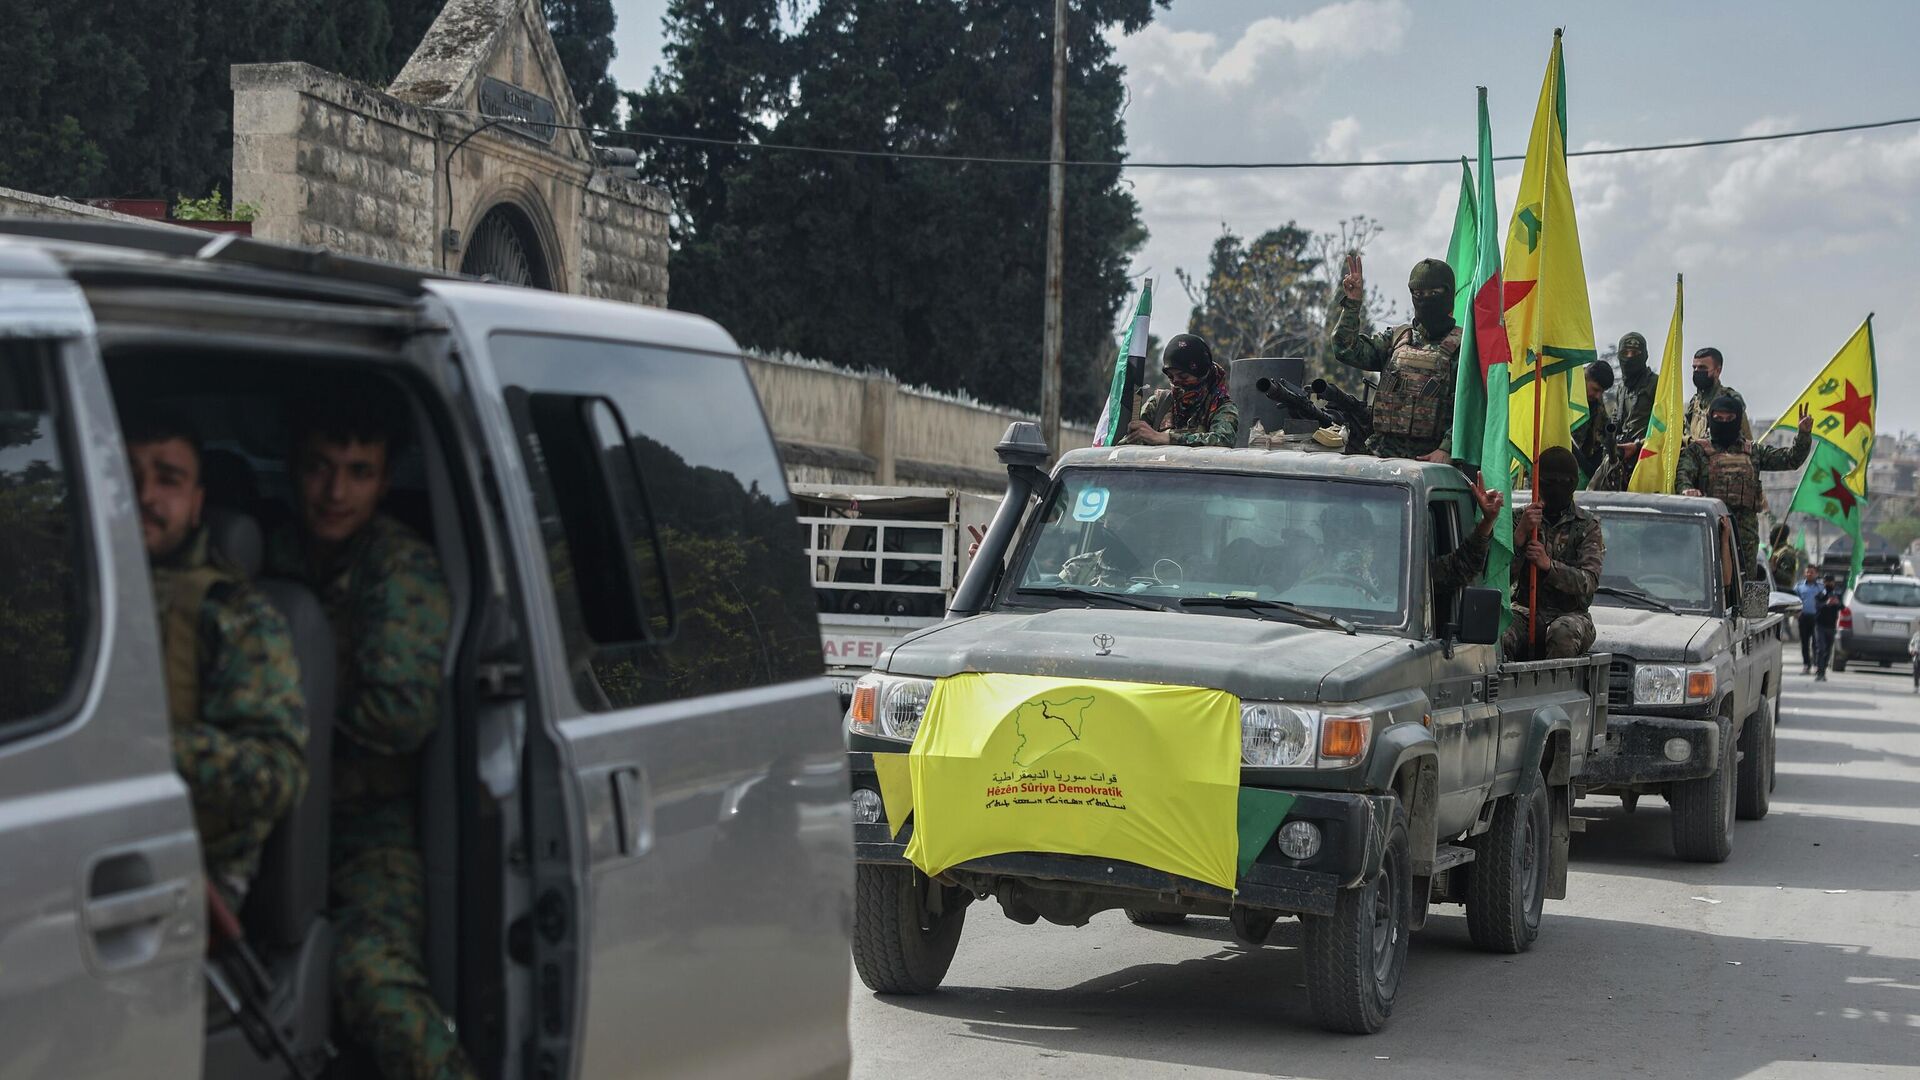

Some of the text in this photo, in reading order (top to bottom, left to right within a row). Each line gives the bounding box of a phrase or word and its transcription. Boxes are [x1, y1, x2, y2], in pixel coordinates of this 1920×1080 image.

[1078, 487, 1105, 518] 9
[992, 769, 1118, 785] قوات سوريا الديمقراطية
[986, 784, 1018, 797] Hêzên
[1020, 782, 1056, 795] Sûriya
